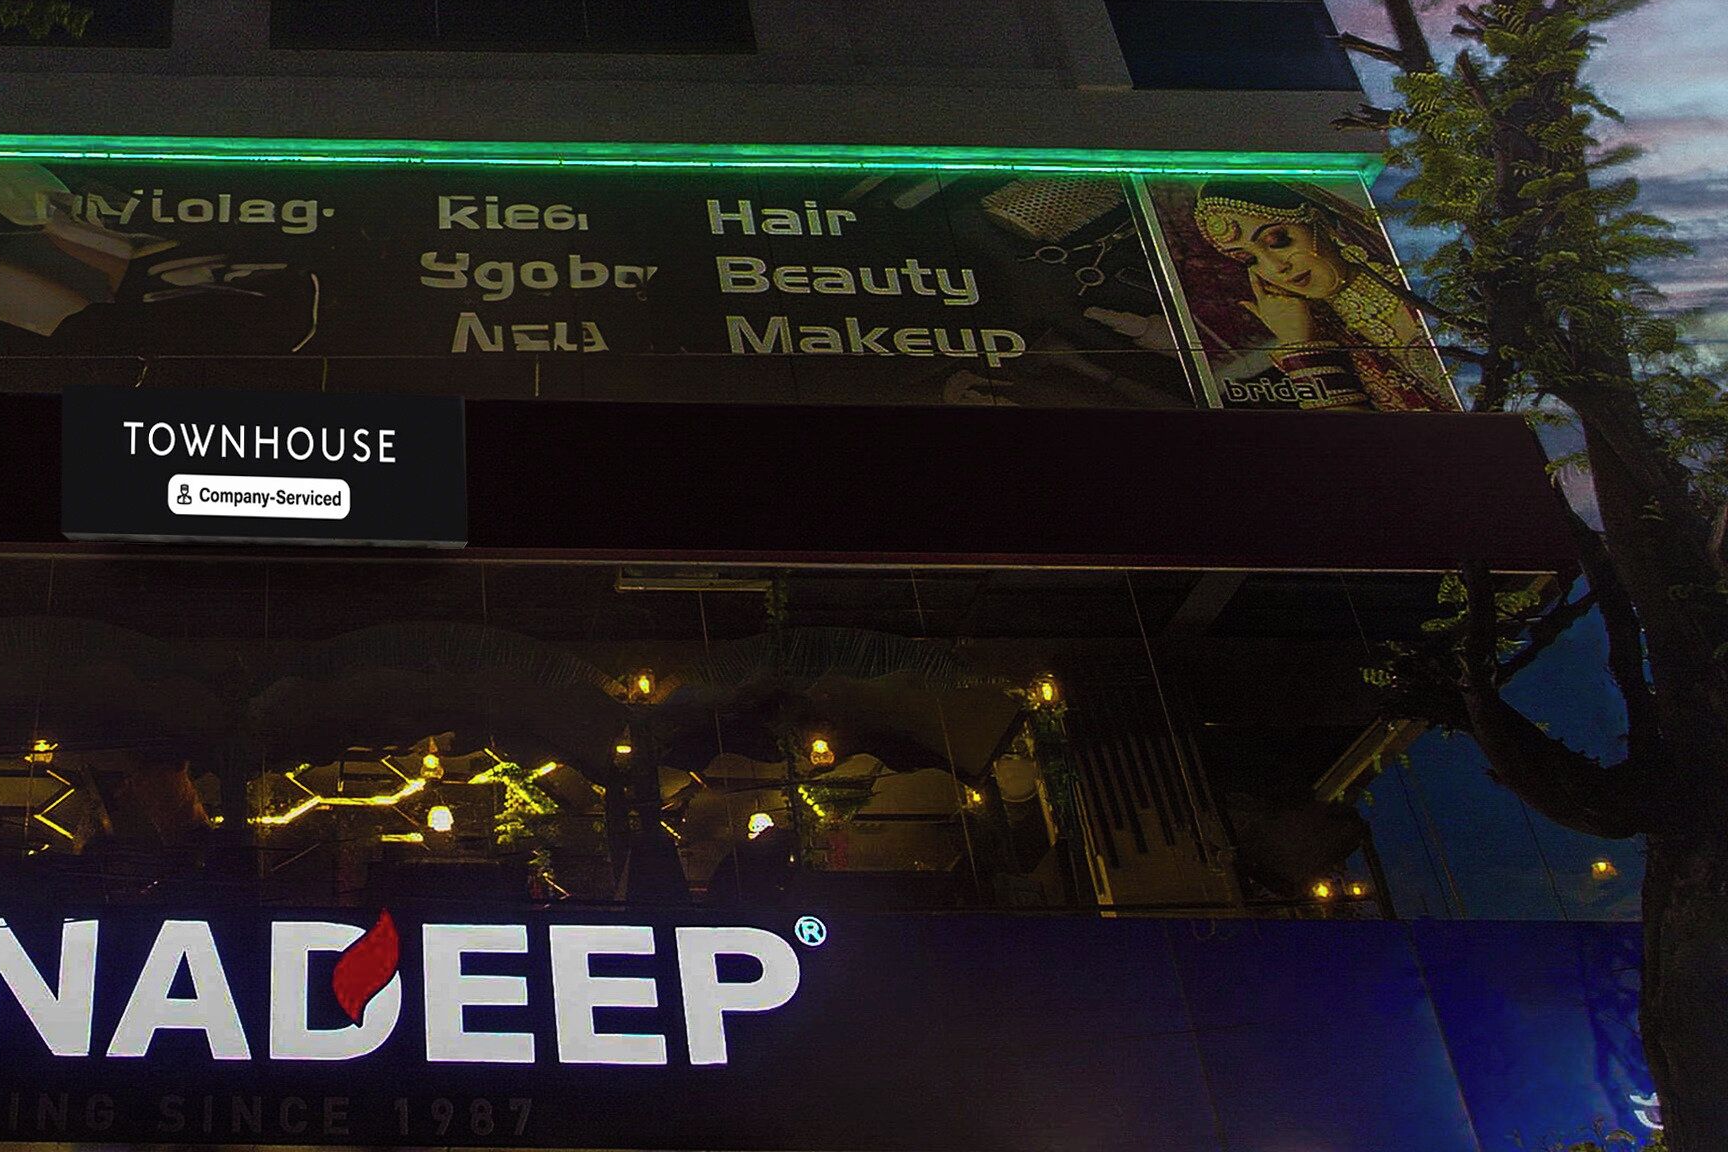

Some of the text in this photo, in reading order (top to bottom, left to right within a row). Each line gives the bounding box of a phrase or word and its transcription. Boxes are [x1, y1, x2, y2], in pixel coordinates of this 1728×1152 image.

[706, 198, 858, 236] Hair
[715, 255, 980, 306] Beauty
[725, 315, 1027, 368] Makeup
[1226, 377, 1329, 404] bridal
[122, 421, 397, 463] TOWNHOUSE
[198, 487, 342, 508] Company-Serviced
[158, 1094, 351, 1135] SINCE
[393, 1096, 534, 1138] 1987
